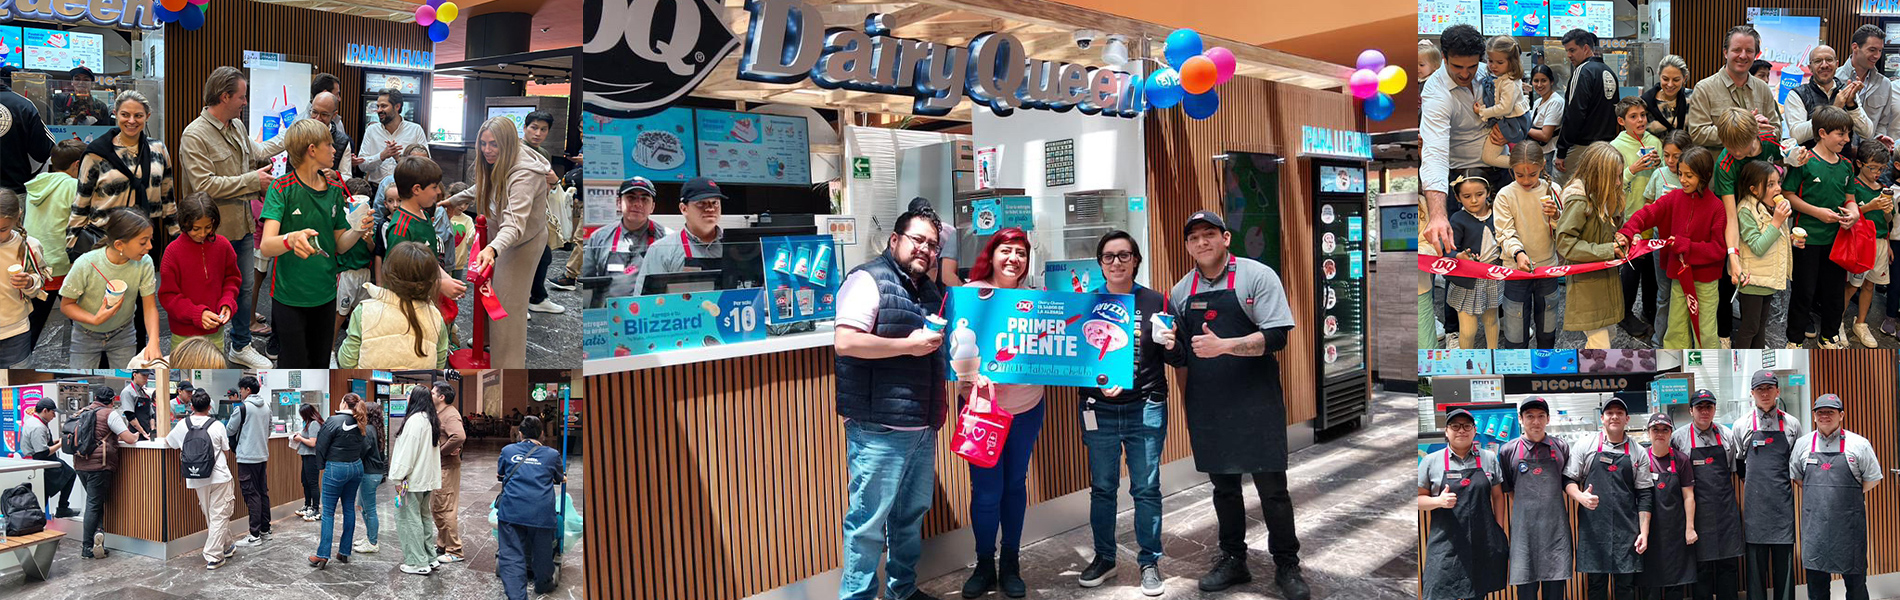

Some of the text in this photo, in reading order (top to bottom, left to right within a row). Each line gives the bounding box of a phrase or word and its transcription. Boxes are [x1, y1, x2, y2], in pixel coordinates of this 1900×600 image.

[1599, 39, 1627, 49] PICO
[1435, 258, 1456, 272] DQ
[624, 313, 702, 335] Blizzard
[724, 305, 756, 333] $10
[1007, 317, 1067, 335] PRIMER
[995, 332, 1077, 357] CLIENTE
[1531, 379, 1569, 391] PICO
[1581, 378, 1628, 390] GALLO
